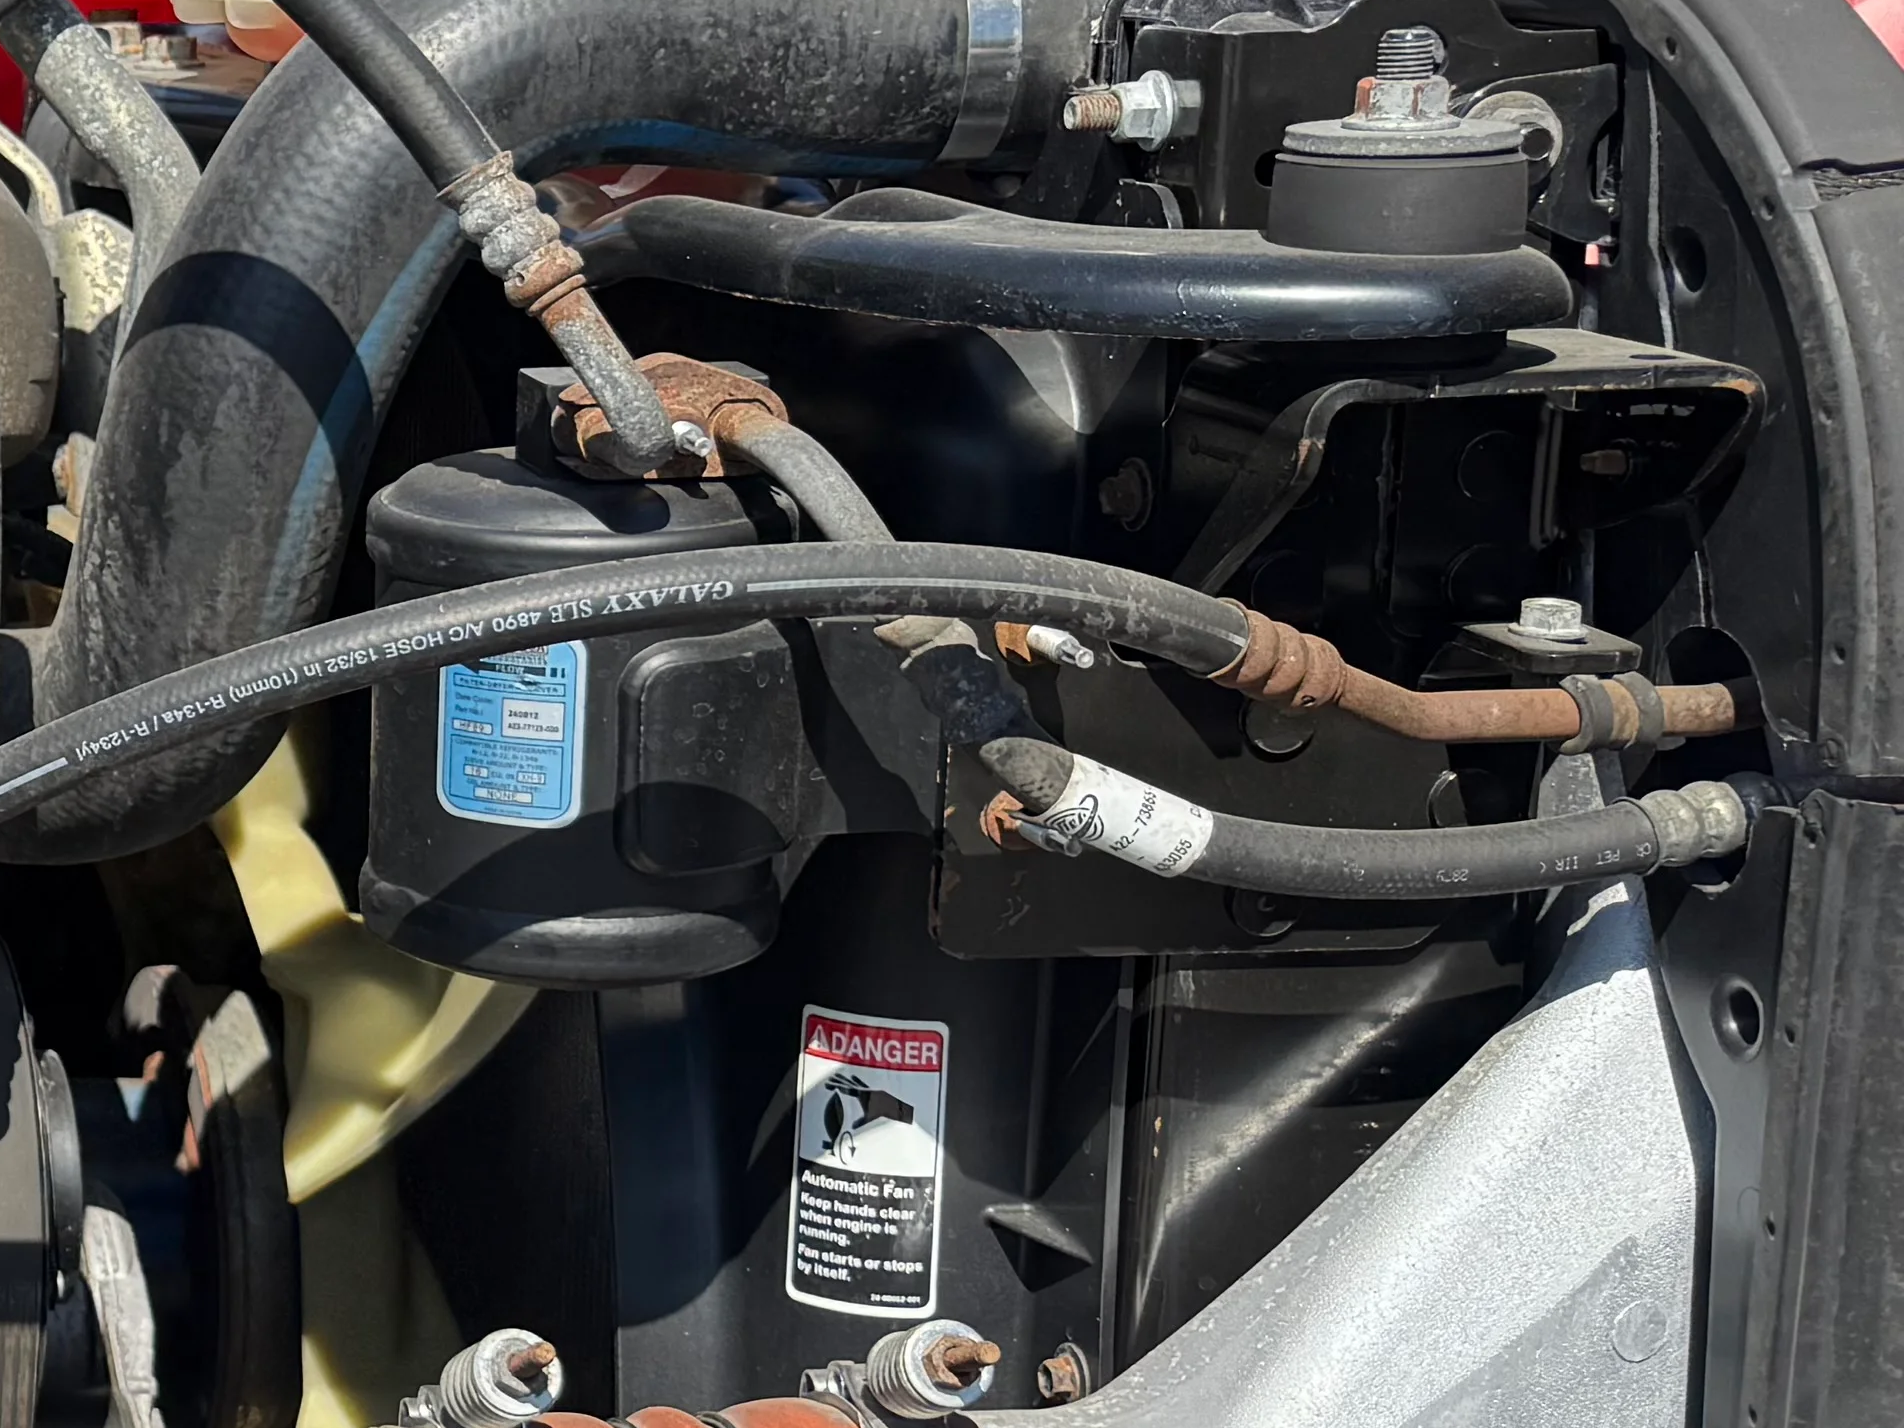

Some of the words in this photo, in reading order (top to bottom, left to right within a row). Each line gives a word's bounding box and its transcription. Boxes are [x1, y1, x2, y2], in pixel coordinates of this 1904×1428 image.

[550, 598, 593, 625] SLE
[601, 579, 735, 616] GALAXY
[449, 620, 484, 642] A/C
[492, 610, 541, 633] 4890
[384, 630, 444, 657] HOSE
[305, 663, 324, 679] in
[325, 644, 381, 674] 13/32
[228, 666, 299, 704] (10mm)
[162, 691, 227, 725] R-134a
[831, 1035, 939, 1067] DANGER
[802, 1169, 880, 1197] Automatic
[883, 1183, 915, 1199] Fan
[800, 1191, 833, 1212] Keep
[833, 1200, 877, 1218] hands
[879, 1207, 917, 1220] clear
[798, 1224, 851, 1247] running.
[799, 1208, 832, 1226] when
[833, 1217, 882, 1234] engine
[884, 1222, 899, 1235] is
[797, 1242, 820, 1260] Fan
[821, 1252, 862, 1269] starts
[864, 1259, 881, 1270] or
[883, 1260, 924, 1274] stops
[797, 1258, 812, 1276] by
[813, 1262, 852, 1282] itself.
